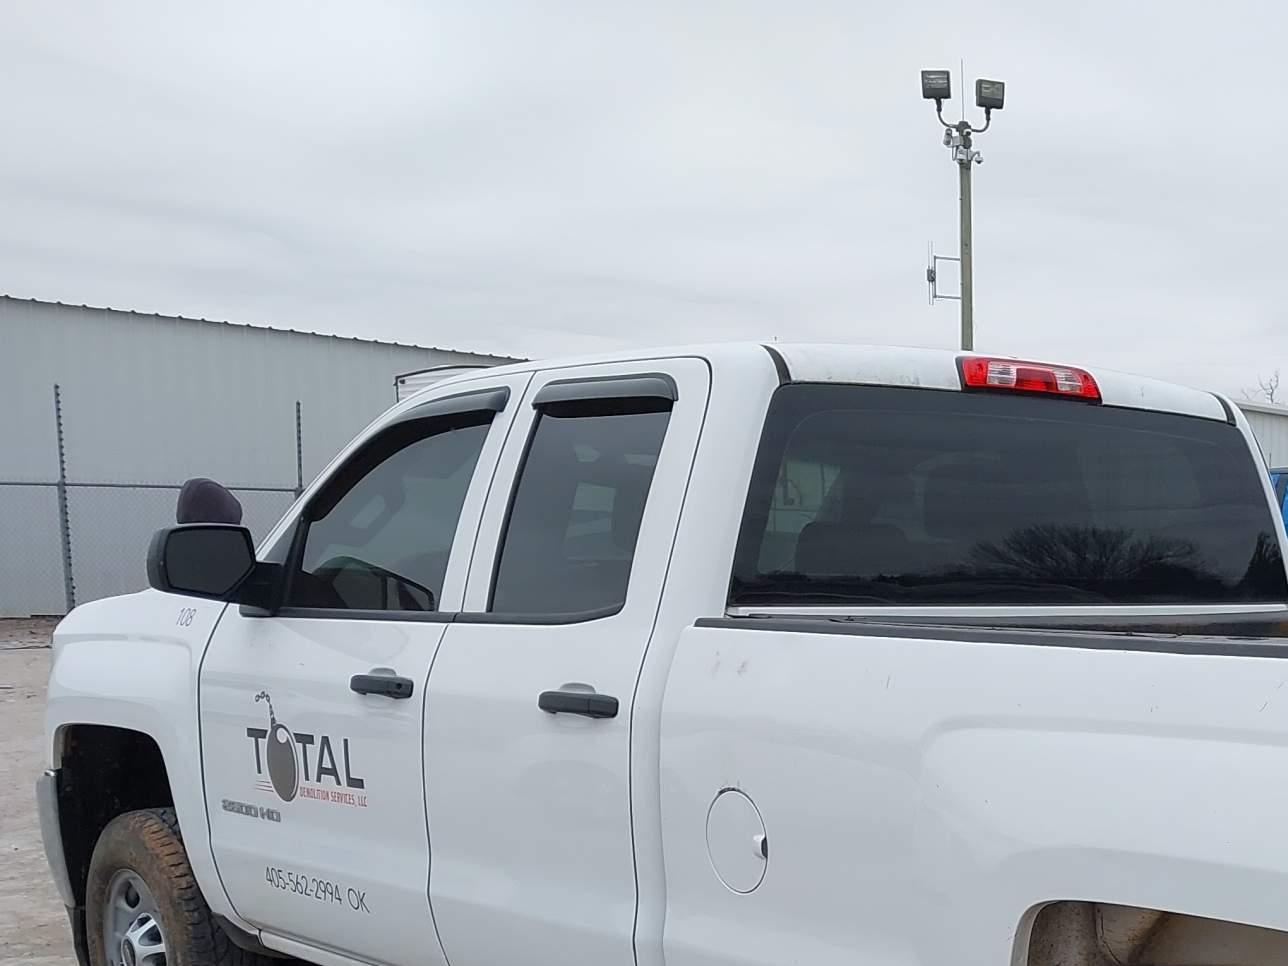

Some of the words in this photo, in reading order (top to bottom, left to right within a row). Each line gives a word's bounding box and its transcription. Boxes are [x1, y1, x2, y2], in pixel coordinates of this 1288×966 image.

[176, 607, 197, 627] 108
[246, 724, 365, 802] TOTAL
[300, 786, 330, 801] DEMOLITION
[265, 865, 343, 904] 405-562-2994
[348, 887, 371, 914] OK
